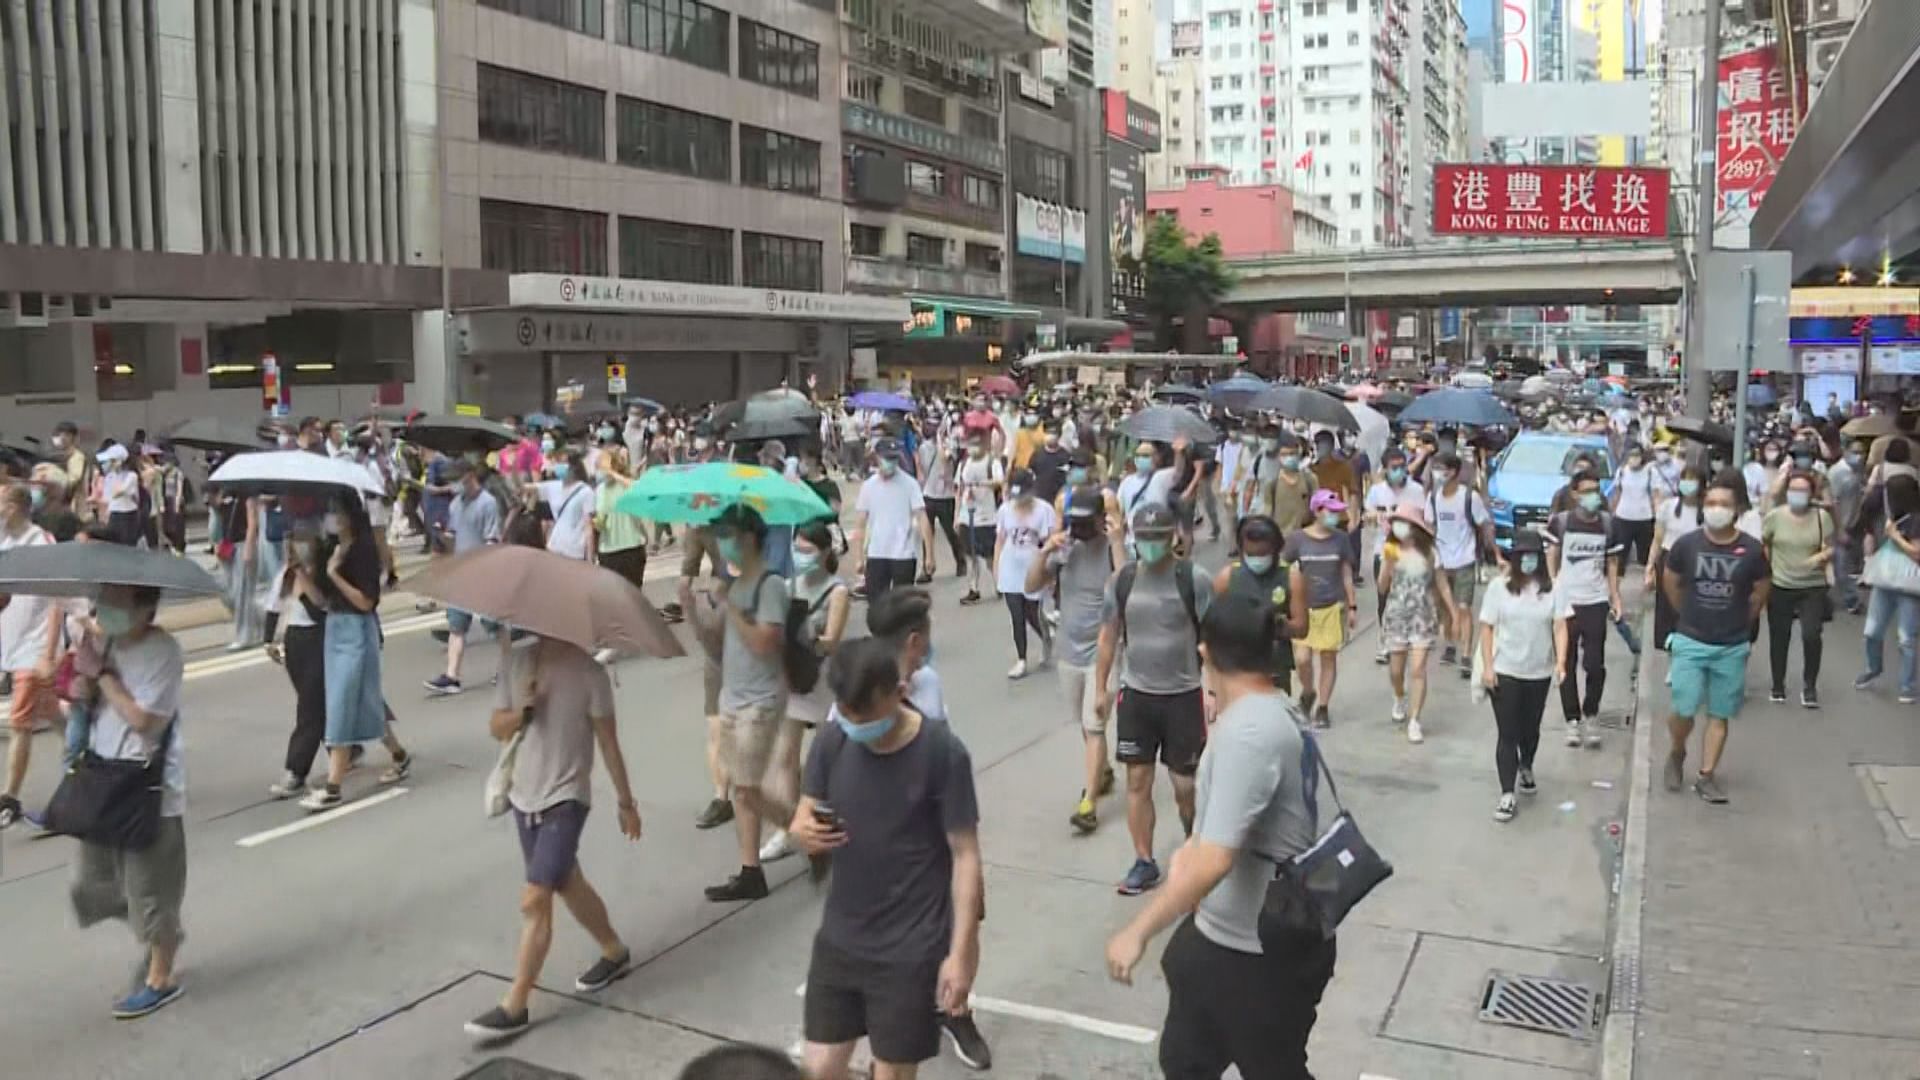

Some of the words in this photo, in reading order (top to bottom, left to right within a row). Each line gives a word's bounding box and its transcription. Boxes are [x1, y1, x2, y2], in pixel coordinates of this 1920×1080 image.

[1451, 171, 1650, 215] 港豐找換
[1450, 214, 1498, 230] KONG
[1505, 215, 1550, 231] FUNG
[1558, 216, 1650, 233] EXCHANGE
[1695, 554, 1741, 581] NY
